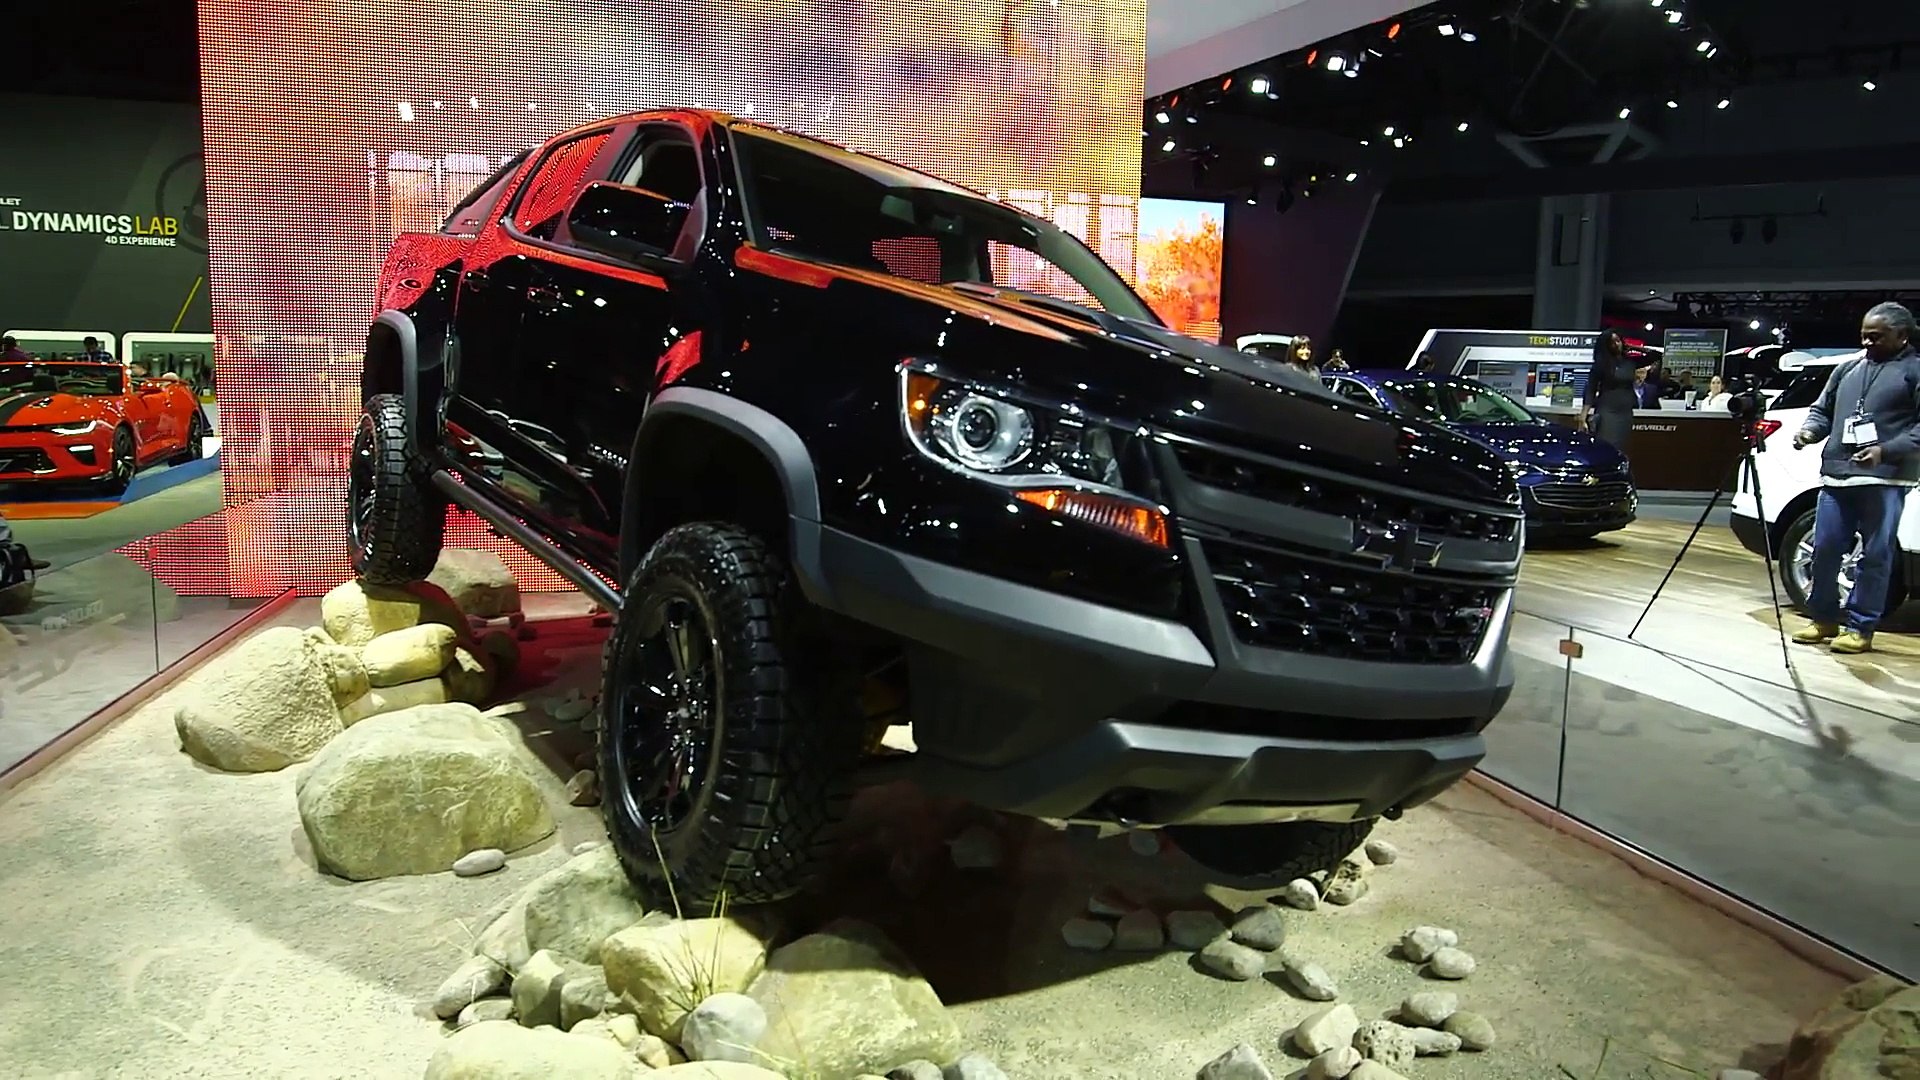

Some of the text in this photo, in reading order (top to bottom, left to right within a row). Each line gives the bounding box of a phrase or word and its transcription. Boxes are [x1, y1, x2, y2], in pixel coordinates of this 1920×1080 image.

[0, 197, 21, 206] LET
[12, 211, 178, 236] DYNAMICS LAB
[105, 235, 177, 247] 4D EXPERIENCE
[1528, 335, 1579, 346] TECHSTUDIO
[1632, 424, 1677, 432] HEVROLET
